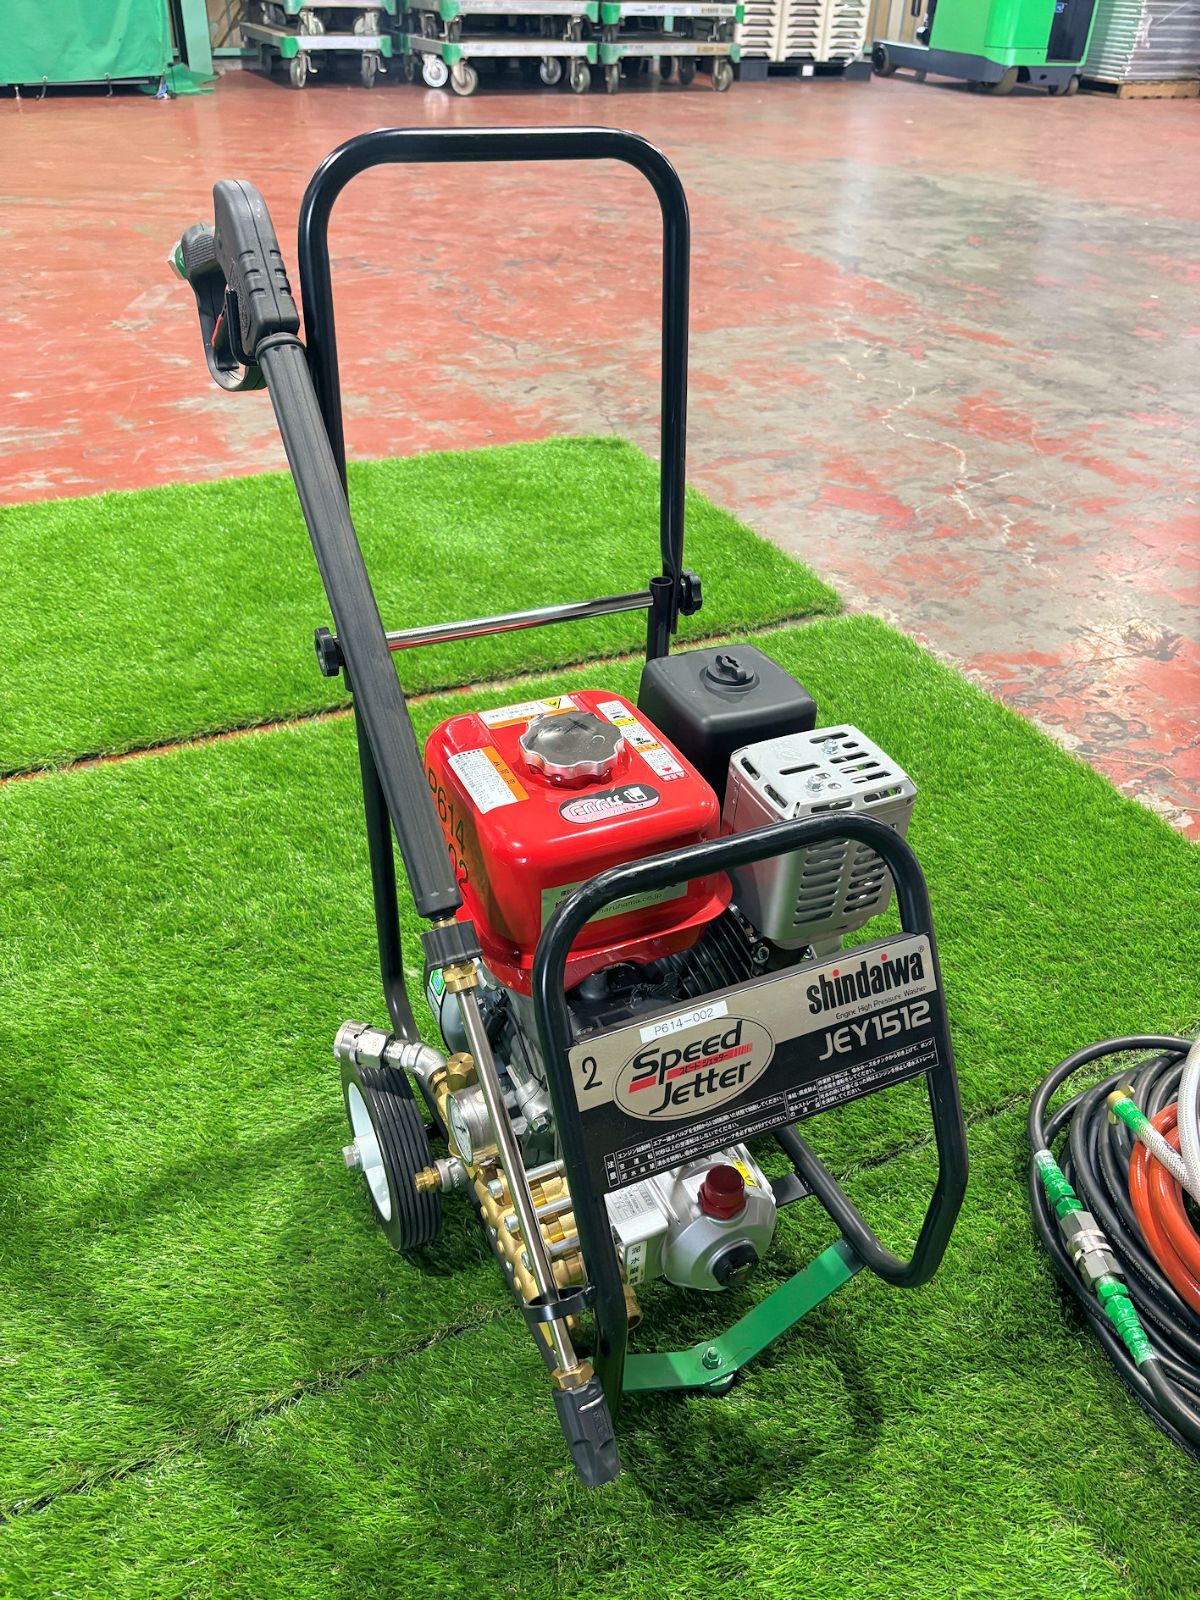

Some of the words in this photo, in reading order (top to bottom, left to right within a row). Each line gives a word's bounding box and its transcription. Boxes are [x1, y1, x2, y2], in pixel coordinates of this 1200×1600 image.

[806, 952, 925, 1015] shindaiwa
[835, 1009, 857, 1020] Engine
[857, 1002, 873, 1014] High
[873, 994, 902, 1008] Pressure
[903, 985, 927, 997] Washer
[654, 1008, 714, 1036] P614-002
[819, 1000, 932, 1061] JEY1512
[582, 1056, 603, 1091] 2
[631, 1019, 743, 1086] Speed
[648, 1060, 752, 1116] Jetter
